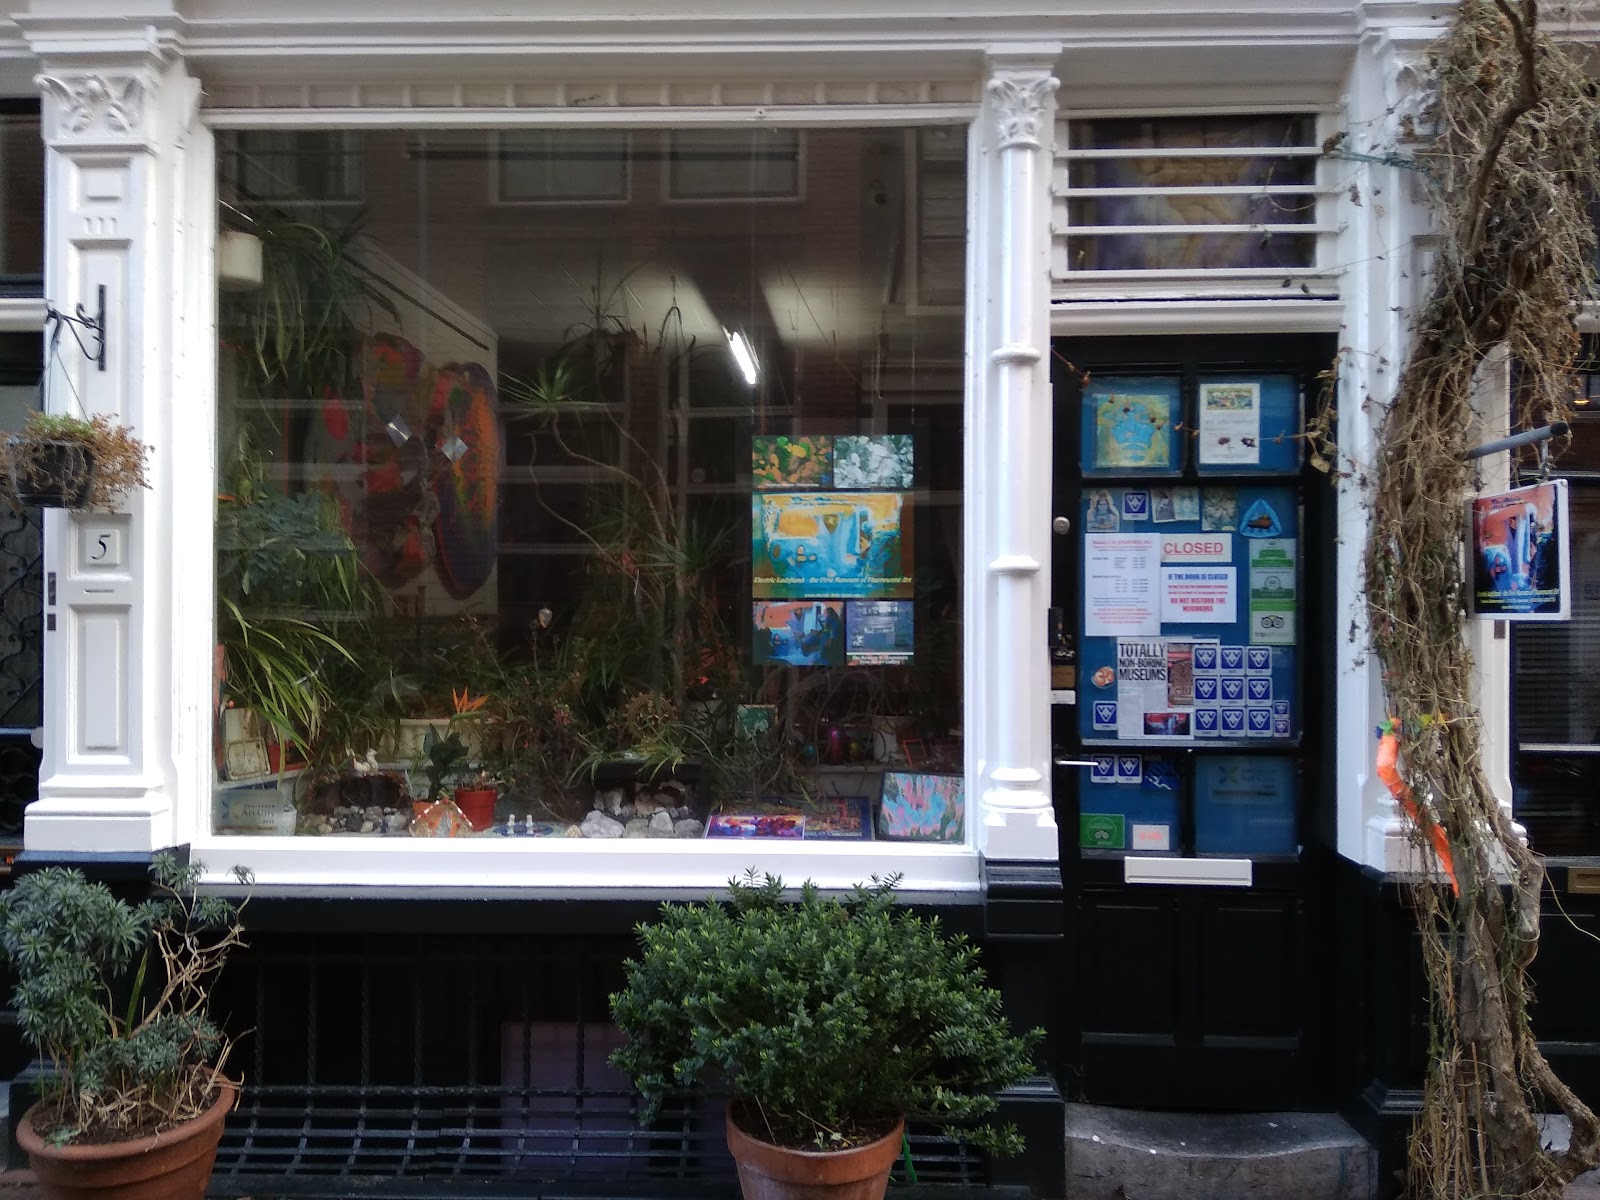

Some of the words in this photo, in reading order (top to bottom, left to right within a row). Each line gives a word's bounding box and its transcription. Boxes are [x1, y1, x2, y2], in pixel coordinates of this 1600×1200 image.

[90, 534, 111, 560] 5
[1164, 543, 1223, 554] CLOSED
[1119, 643, 1166, 658] TOTALLY
[1119, 657, 1166, 668] NON-BORING
[1119, 668, 1166, 681] MUSEUMS
[257, 809, 274, 818] City
